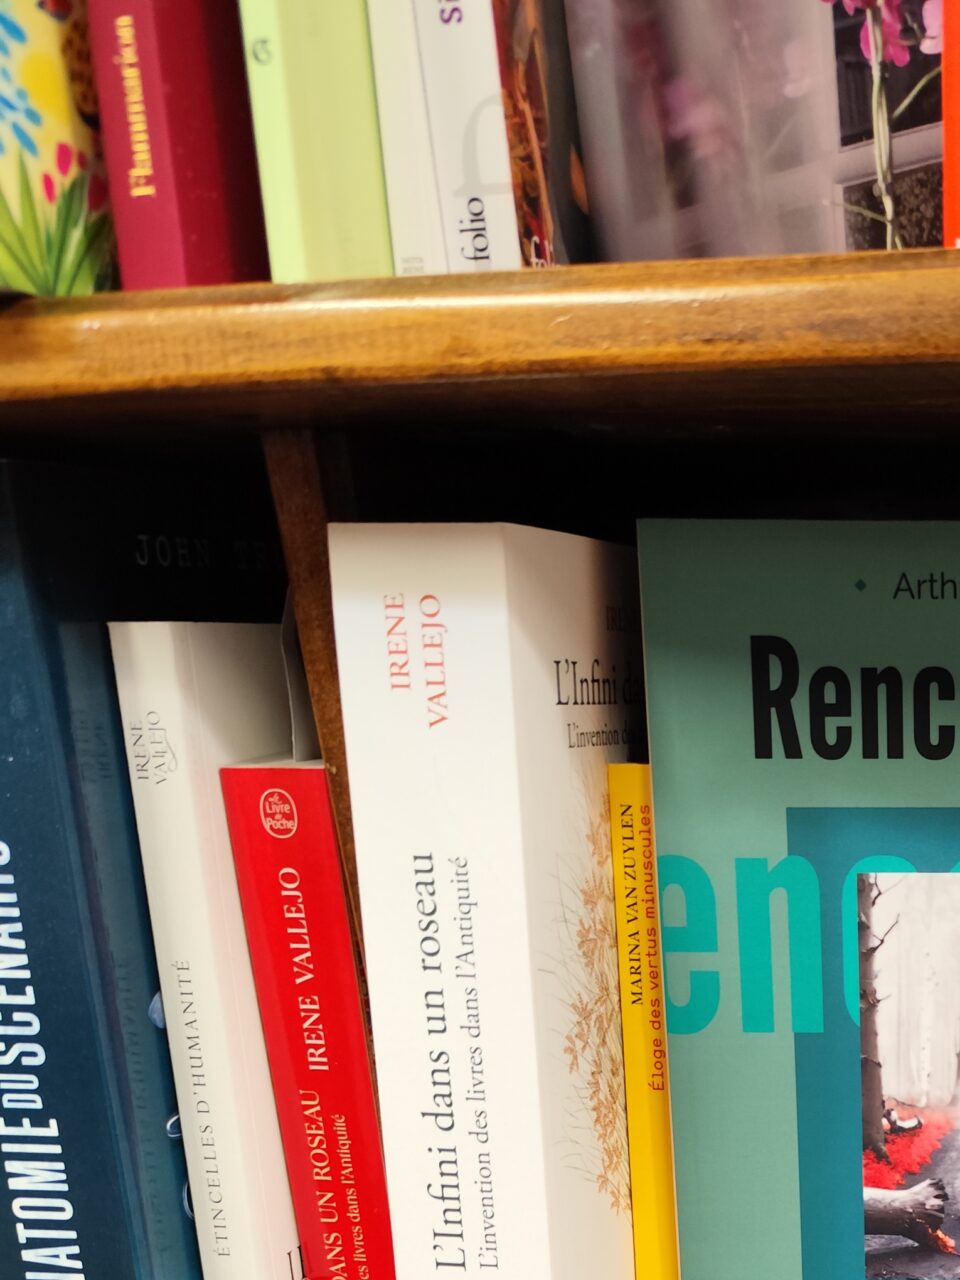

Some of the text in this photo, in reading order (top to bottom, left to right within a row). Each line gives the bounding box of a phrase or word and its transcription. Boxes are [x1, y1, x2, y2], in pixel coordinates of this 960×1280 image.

[459, 197, 490, 262] folio
[384, 592, 411, 691] IRENE
[420, 593, 449, 730] VALLEJO
[554, 659, 617, 705] L'Infini
[567, 722, 619, 748] L'invention
[265, 801, 291, 814] Livre
[266, 816, 295, 829] Poche
[278, 867, 315, 985] VALLEJO
[620, 803, 645, 1005] MARINA VAN ZUYLEN
[640, 805, 666, 1091] Éloge des vertus minuscules
[300, 995, 331, 1072] IRENE
[412, 851, 467, 1272] L'Infini dans un roseau
[449, 855, 499, 1270] L'invention des livres dans l'Antiquité
[0, 1074, 43, 1109] DU
[171, 960, 231, 1257] ÉTINCELLES D'HUMANITÉ
[300, 1089, 334, 1181] ROSEAU
[321, 1190, 338, 1229] UN
